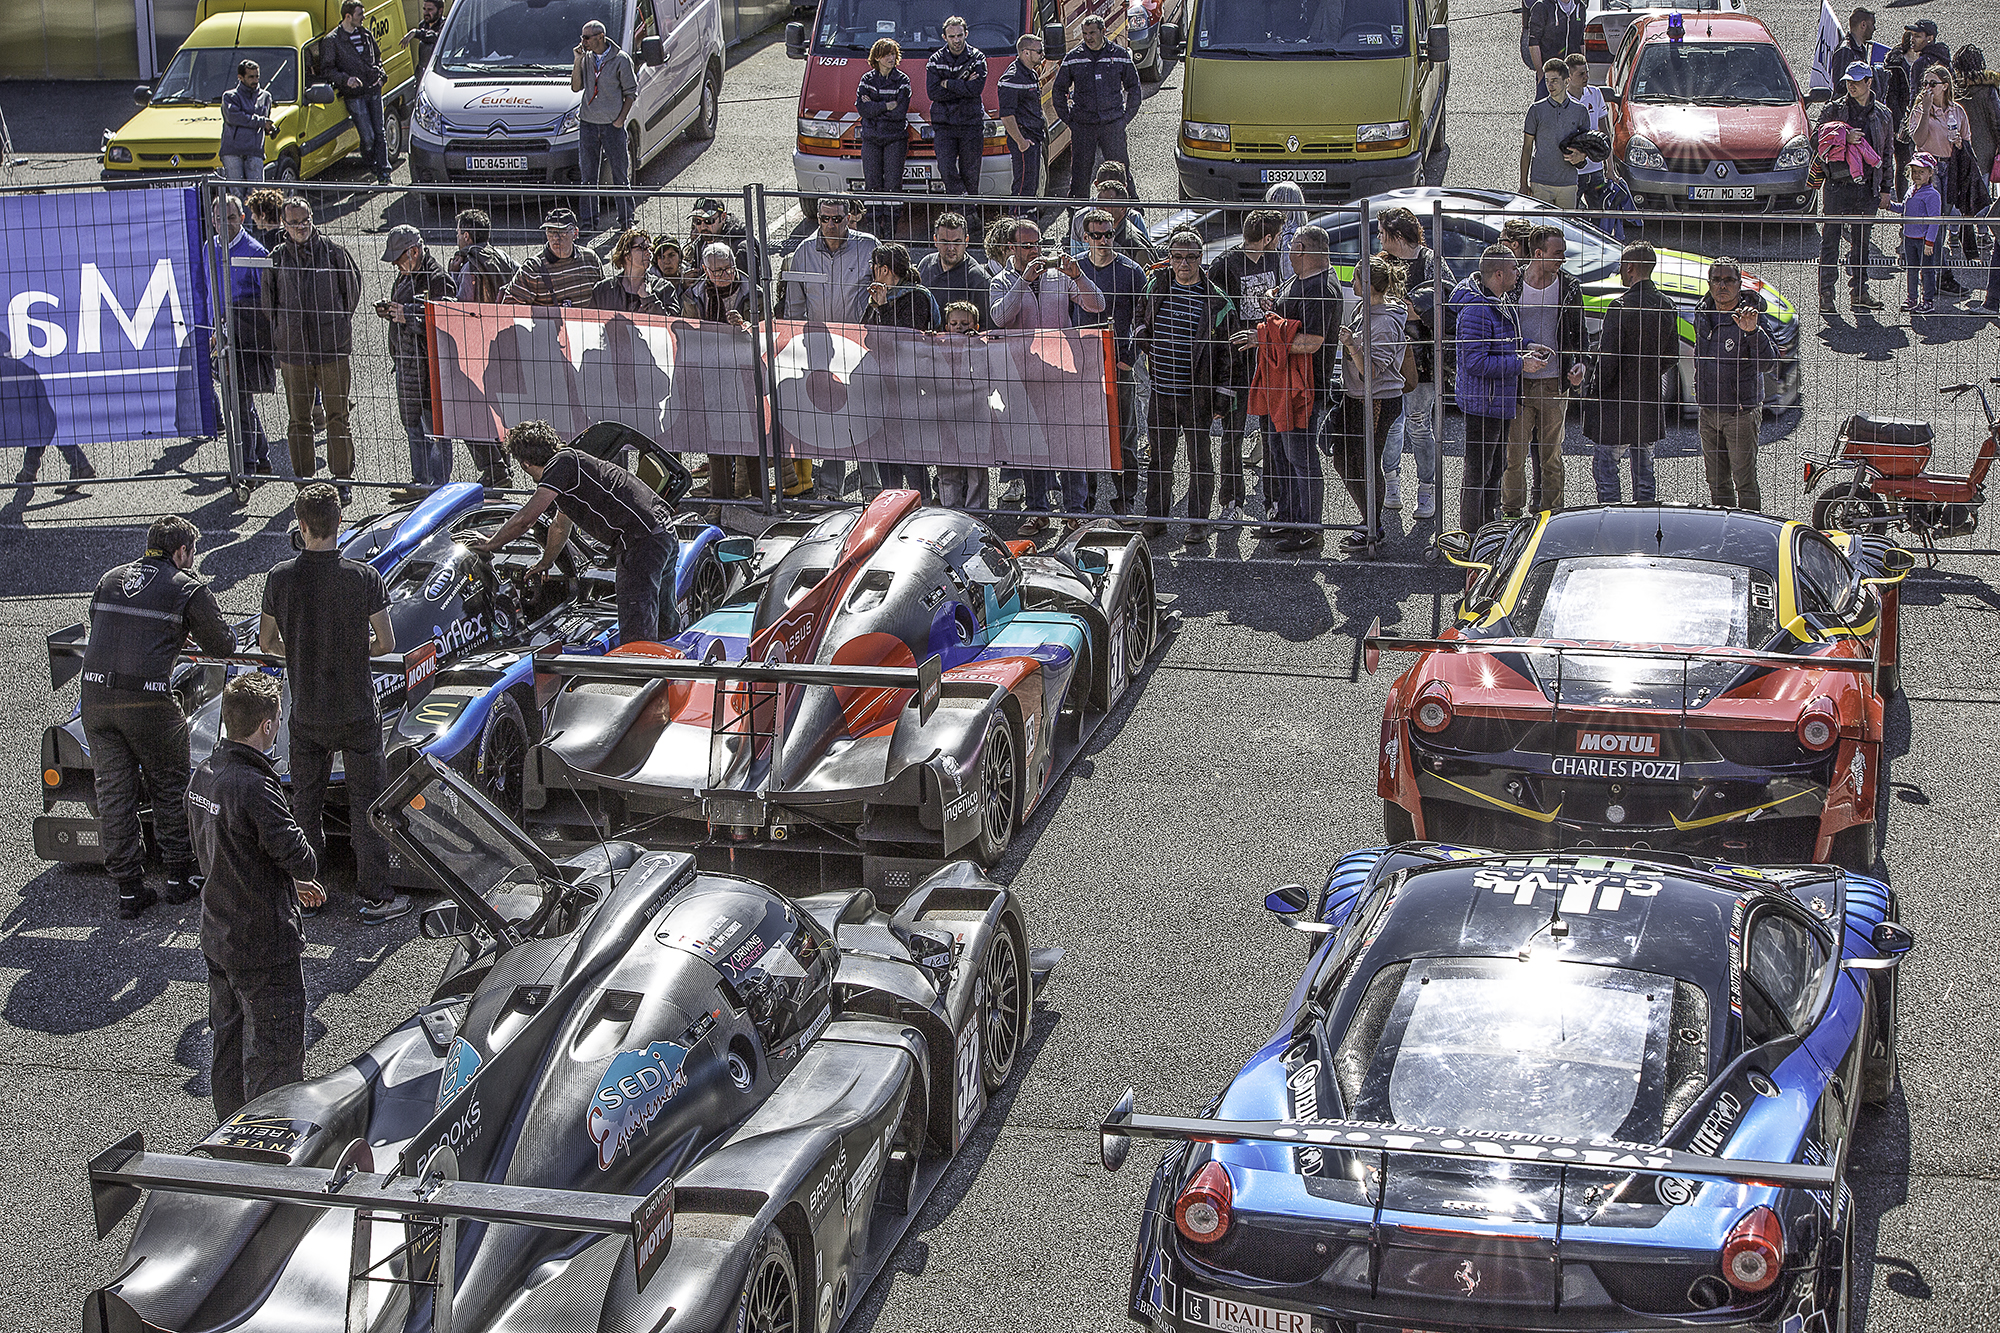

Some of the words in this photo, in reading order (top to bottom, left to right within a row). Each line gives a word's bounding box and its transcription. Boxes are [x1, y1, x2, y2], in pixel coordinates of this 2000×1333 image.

[818, 57, 848, 66] VSAB
[903, 167, 925, 178] 2-NR
[1268, 171, 1294, 182] 8392
[1296, 171, 1309, 182] LX
[1311, 171, 1325, 182] 32
[1696, 187, 1716, 199] 477
[433, 613, 487, 659] airflex
[784, 620, 812, 653] ASSUS
[408, 655, 437, 688] MOTUL
[143, 681, 167, 692] MRTC
[1580, 733, 1656, 753] MOTUL
[1551, 757, 1627, 778] CHARLES
[1631, 760, 1681, 781] POZZI
[944, 790, 979, 823] ingenico
[732, 934, 763, 963] DRIVING
[739, 941, 768, 970] KONCEPT
[957, 1031, 980, 1121] 32
[220, 1125, 285, 1139] REIMS
[1456, 1126, 1580, 1146] solution
[1588, 1136, 1673, 1158] Votre
[809, 1148, 848, 1213] BROOKS
[645, 1181, 673, 1220] DRIVING
[639, 1209, 674, 1270] MOTUL
[1212, 1299, 1305, 1333] TRAILER
